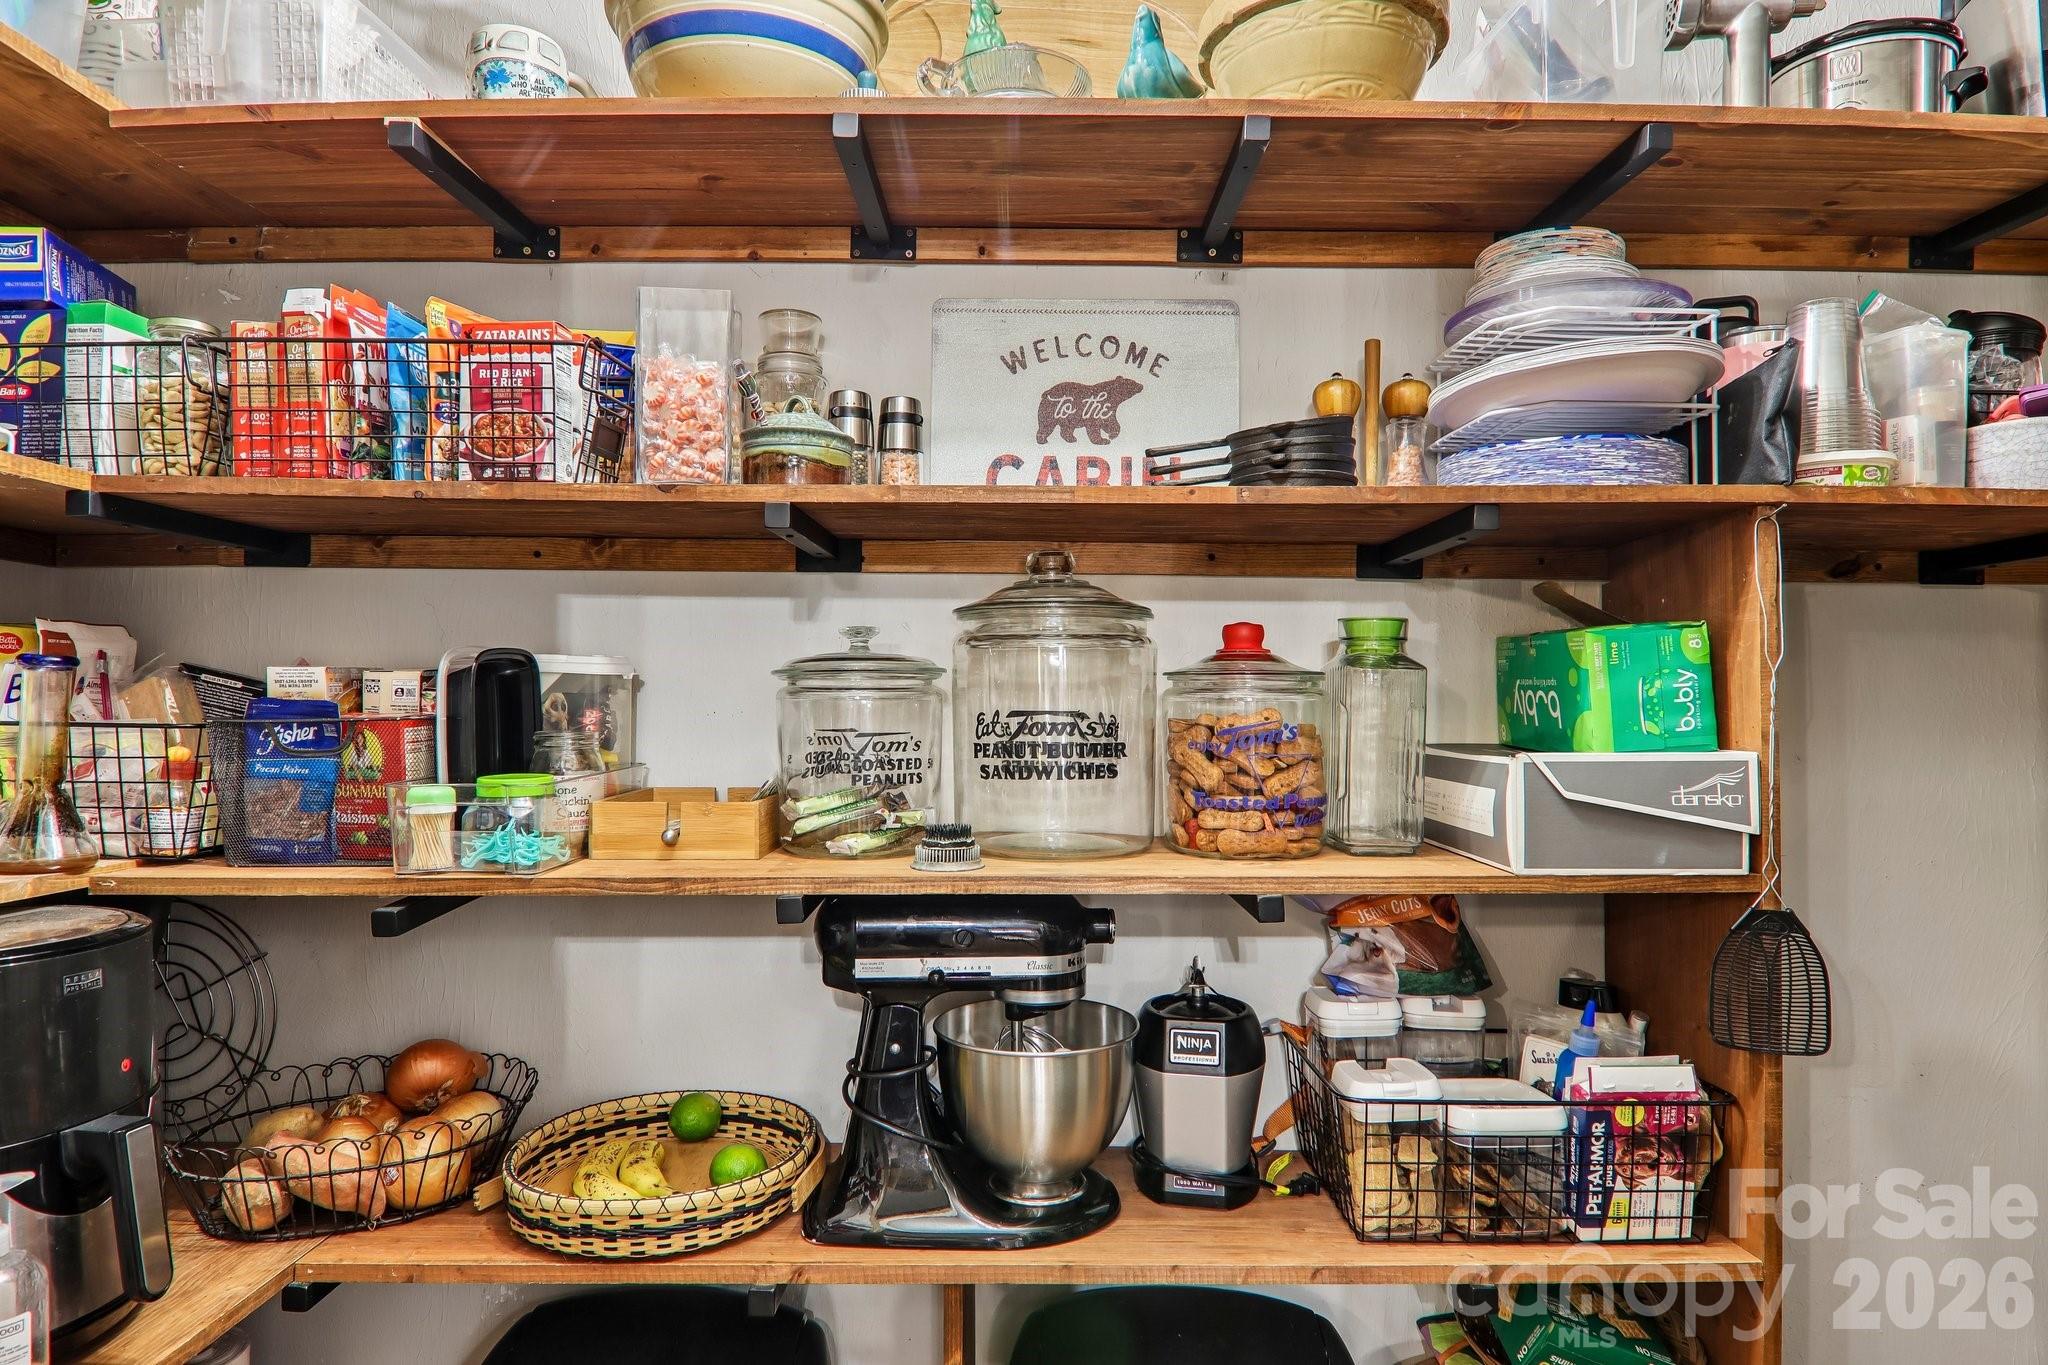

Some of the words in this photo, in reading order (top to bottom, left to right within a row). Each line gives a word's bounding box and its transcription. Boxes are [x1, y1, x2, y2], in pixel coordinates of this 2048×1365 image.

[511, 81, 528, 89] WHO
[1826, 79, 1869, 94] Tastmaster
[475, 328, 552, 341] ZATARAIN'S
[1000, 333, 1170, 378] WELCOME
[500, 377, 524, 387] RICE
[1046, 395, 1076, 419] to
[1080, 391, 1112, 419] the
[1688, 638, 1702, 648] 8
[1609, 641, 1619, 665] lime
[1513, 679, 1563, 729] bubly
[1672, 668, 1699, 732] bubly
[854, 732, 922, 759] Tom's
[1216, 720, 1298, 757] Tom's
[851, 772, 923, 786] PEANUTS
[980, 763, 1119, 780] SANDWICHES
[1671, 785, 1742, 808] dansko
[1357, 904, 1390, 924] JERKY
[1390, 897, 1422, 915] CUTS
[1027, 959, 1054, 971] Classic
[1177, 1034, 1212, 1053] NINJA
[1173, 1055, 1216, 1063] PROFESSIONAL
[1516, 1345, 1529, 1362] NO
[1634, 1345, 1651, 1358] NO
